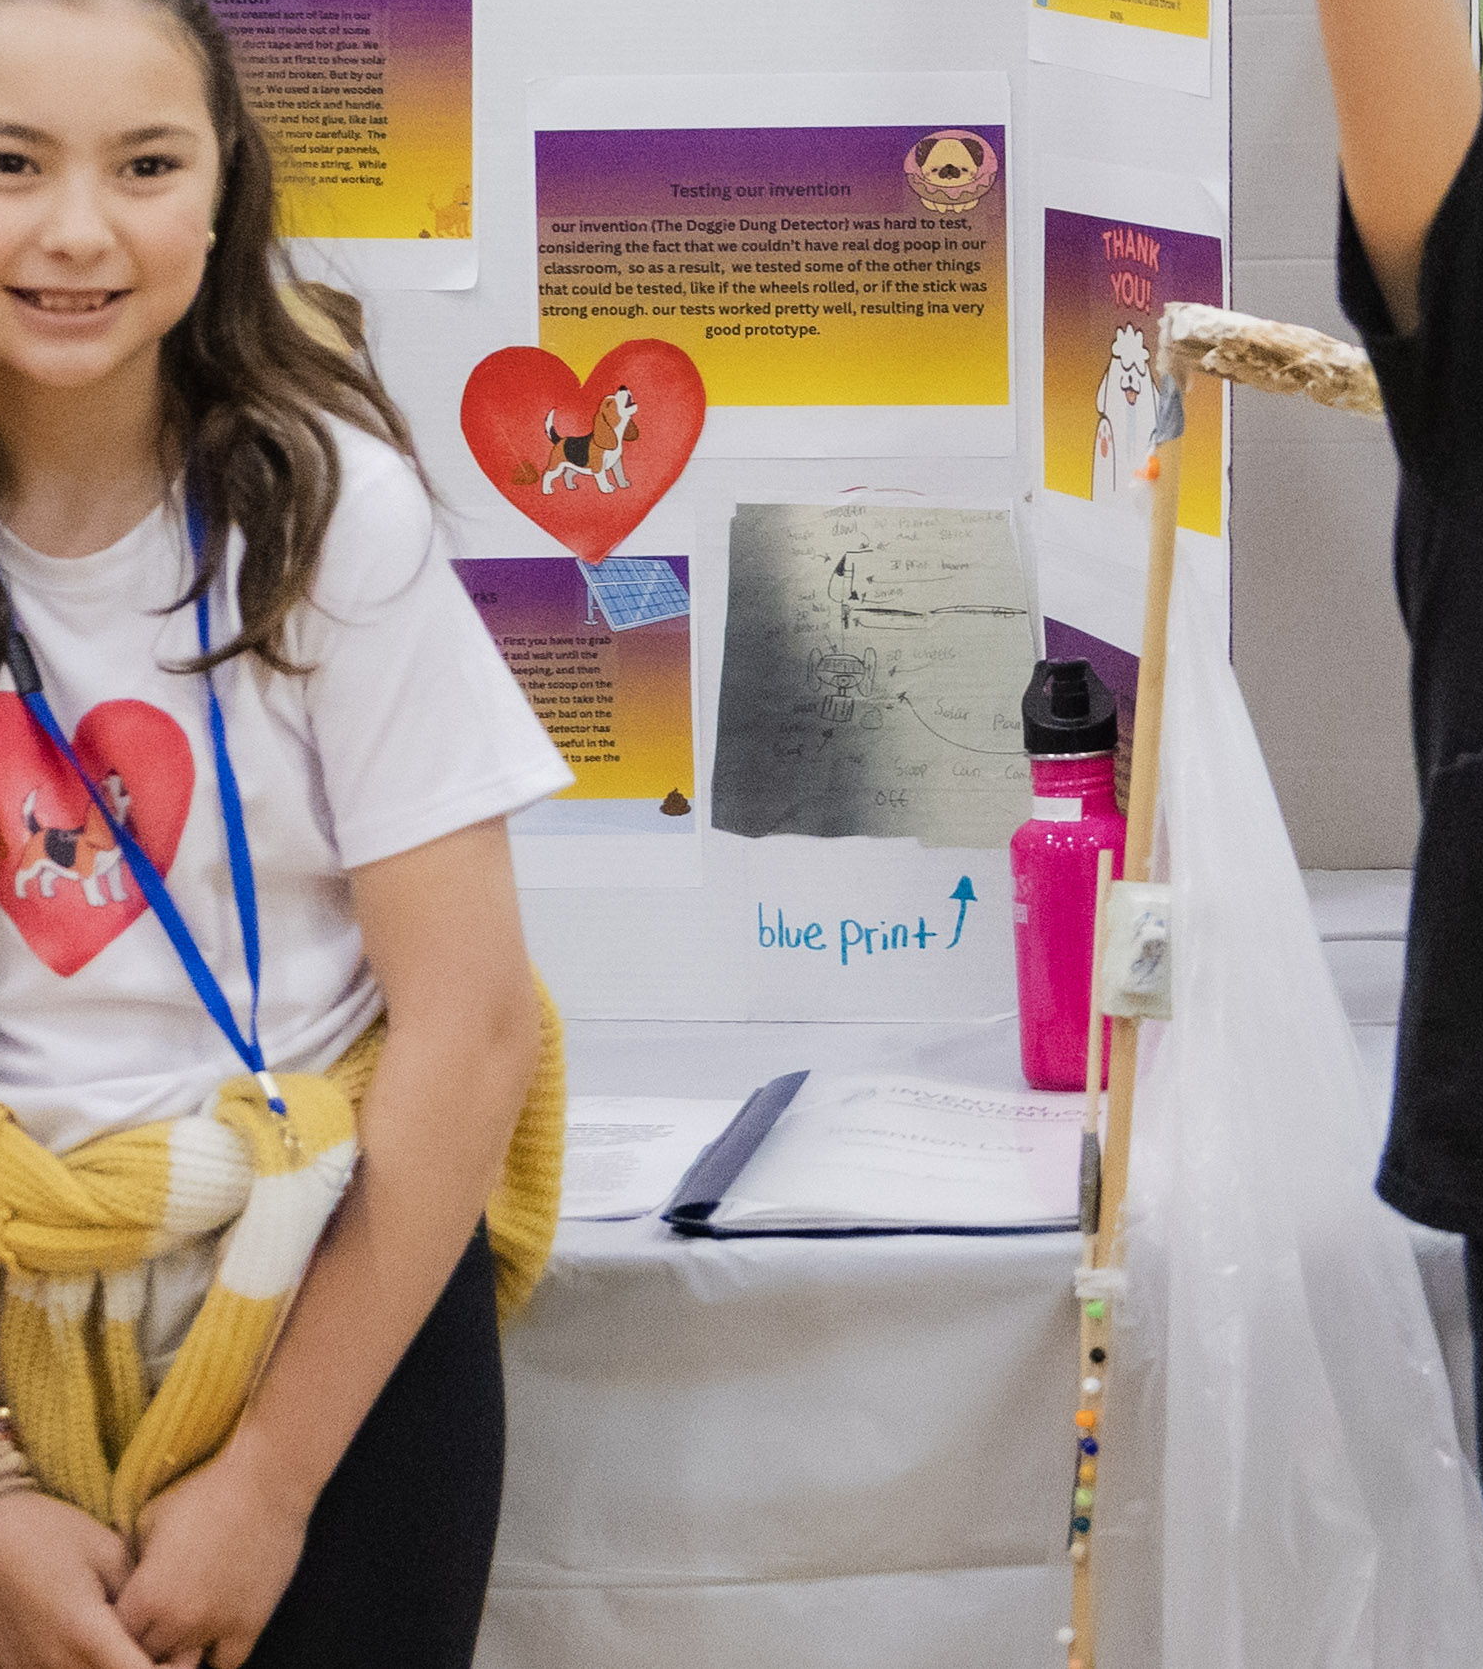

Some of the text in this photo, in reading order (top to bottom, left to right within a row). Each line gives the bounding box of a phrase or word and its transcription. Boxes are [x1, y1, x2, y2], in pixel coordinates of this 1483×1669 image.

[671, 183, 851, 203] Testing our invention
[552, 223, 575, 234] our
[580, 220, 647, 233] invention
[687, 219, 735, 236] Doggie
[739, 219, 777, 235] Dung
[853, 221, 880, 231] was
[884, 218, 917, 231] hard
[920, 218, 936, 231] to
[538, 238, 986, 257] considering the fact that we couldn't have real dog poop in our
[1100, 228, 1161, 274] THANK
[629, 264, 645, 274] so
[648, 263, 664, 273] as
[668, 263, 676, 273] a
[732, 263, 752, 273] we
[755, 260, 801, 273] tested
[805, 262, 843, 273] some
[847, 259, 862, 272] of
[866, 259, 889, 272] the
[893, 259, 932, 272] other
[936, 259, 981, 275] things
[538, 282, 568, 295] that
[572, 282, 611, 295] could
[615, 281, 633, 295] be
[690, 281, 715, 294] like
[719, 281, 728, 294] if
[732, 281, 756, 294] the
[760, 280, 809, 294] wheels
[863, 283, 877, 293] or
[882, 280, 892, 293] if
[895, 280, 919, 293] the
[923, 280, 956, 293] stick
[960, 283, 988, 293] was
[1110, 270, 1152, 315] YOU!
[541, 302, 587, 319] strong
[652, 305, 675, 315] our
[680, 302, 715, 315] tests
[719, 301, 771, 315] worked
[775, 301, 819, 318] pretty
[861, 301, 924, 317] resulting
[953, 304, 985, 317] very
[705, 322, 741, 339] good
[758, 902, 938, 965] blue print
